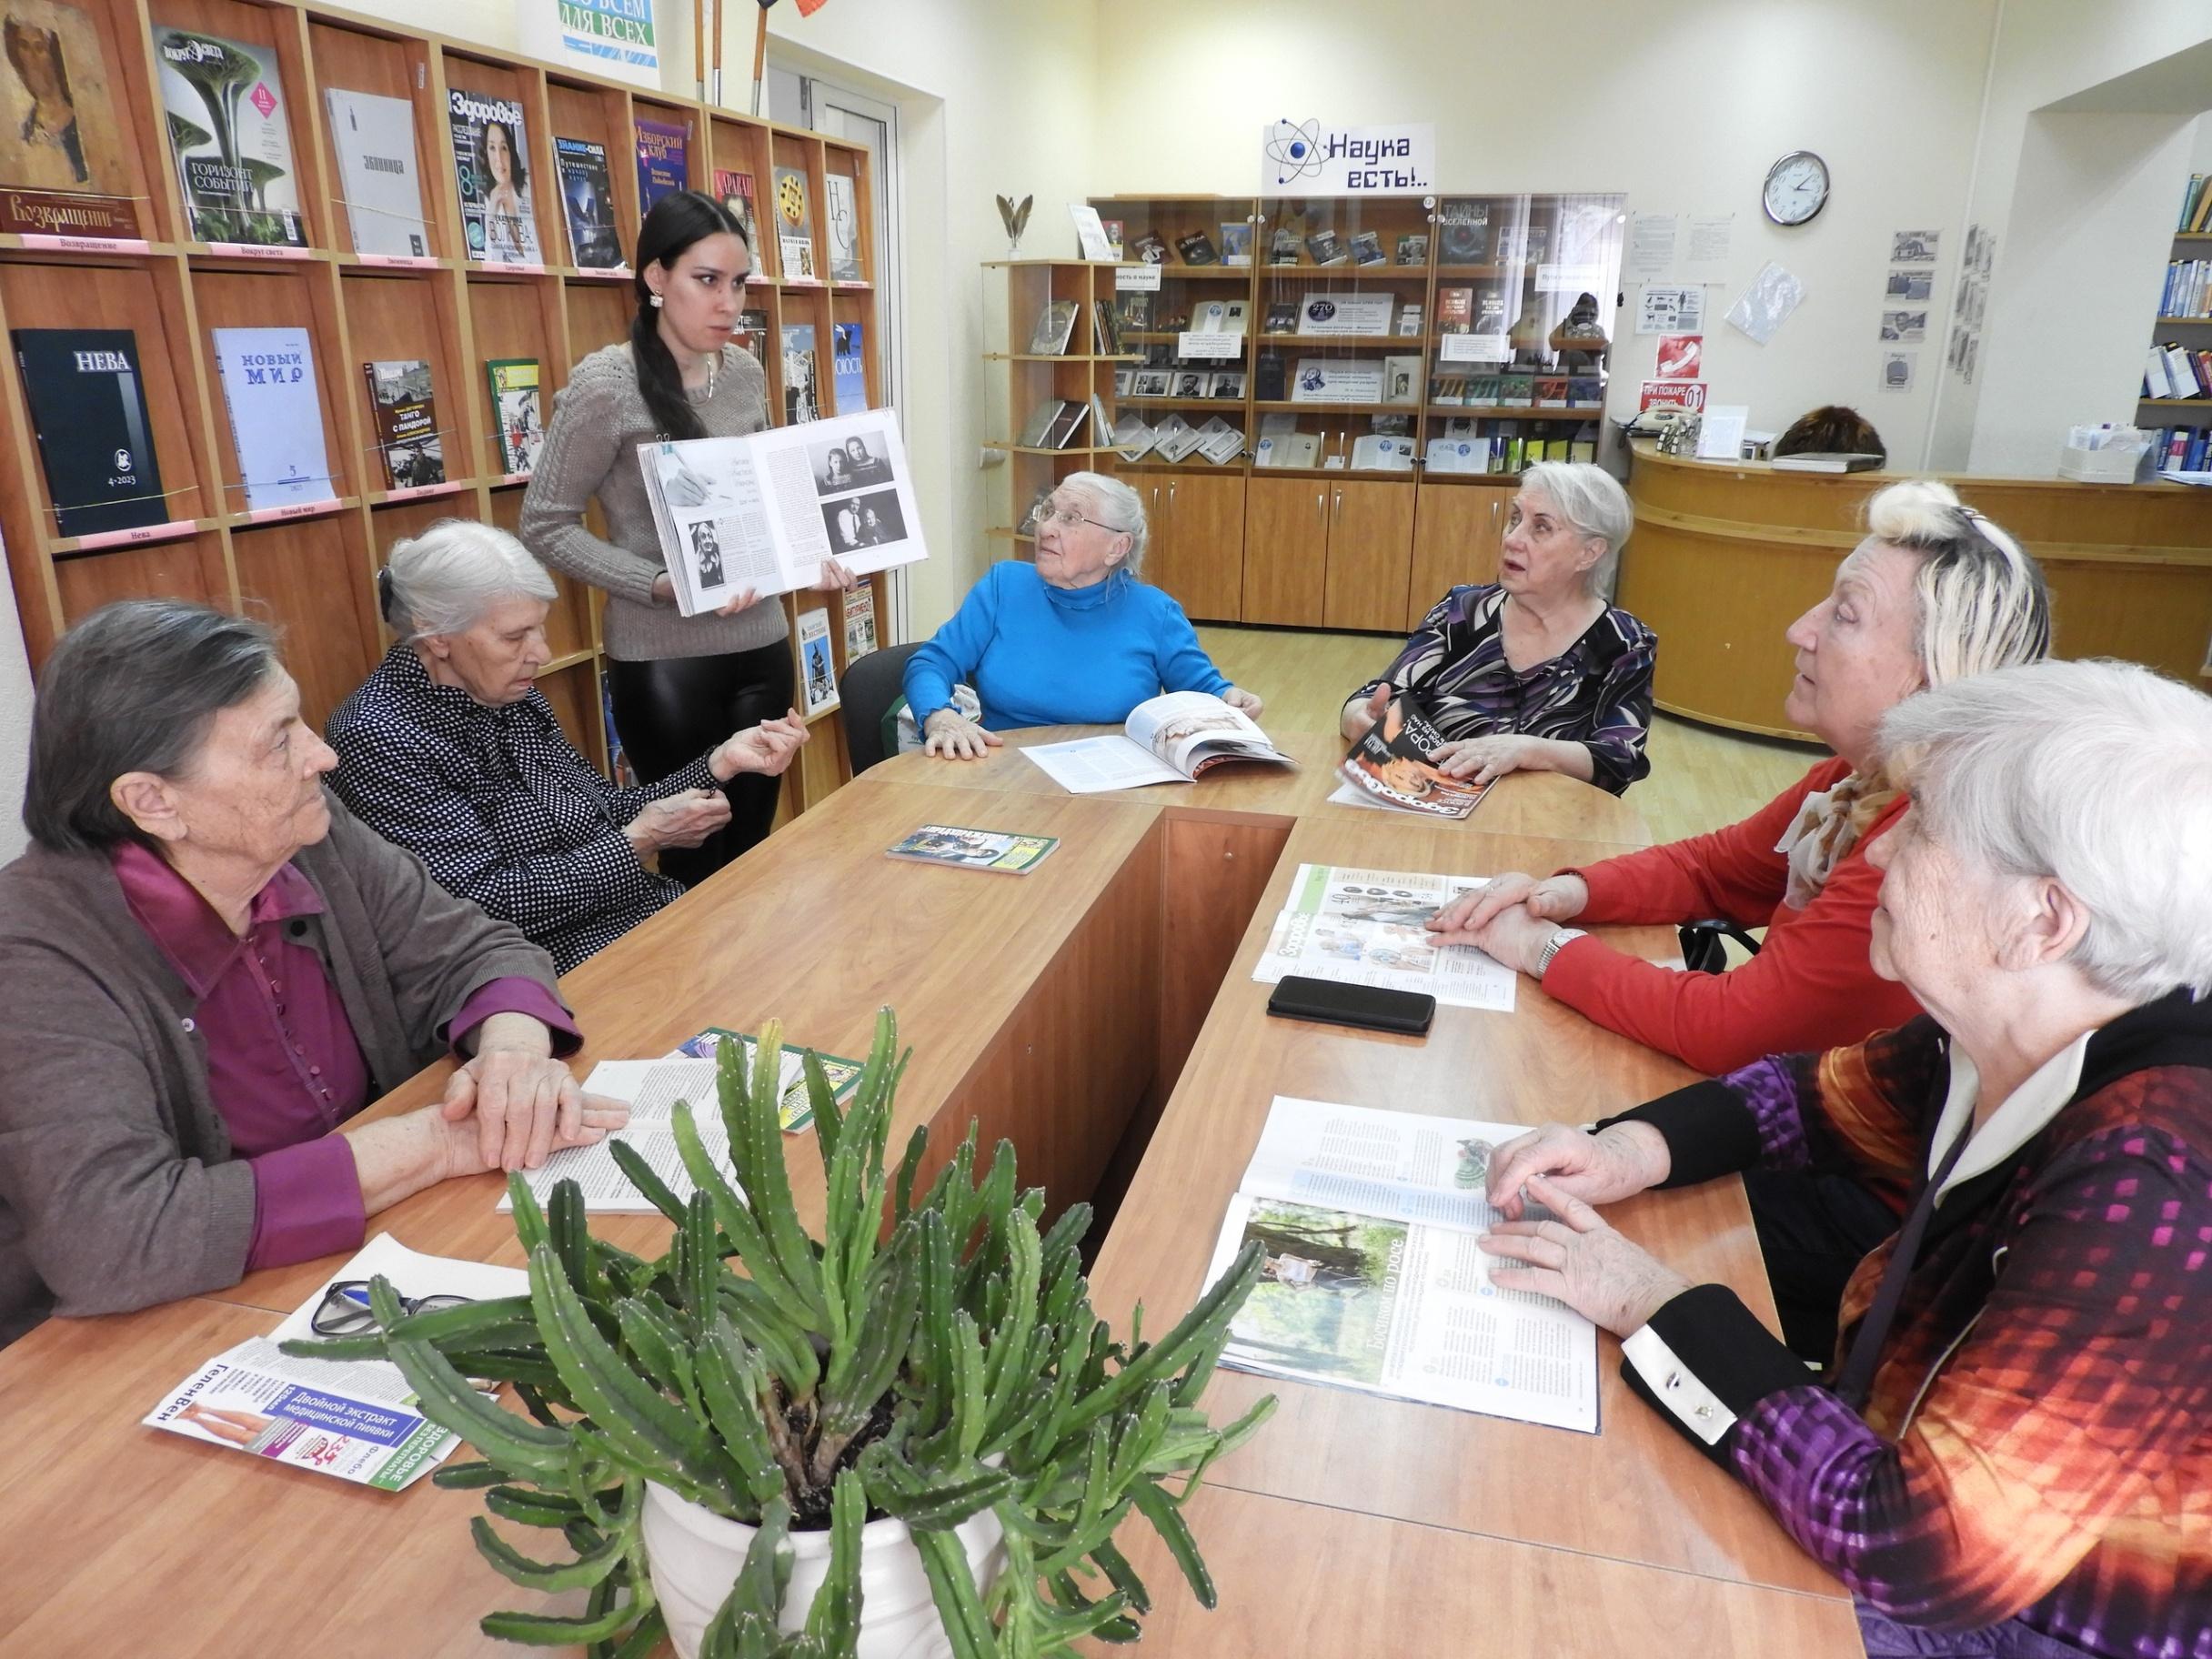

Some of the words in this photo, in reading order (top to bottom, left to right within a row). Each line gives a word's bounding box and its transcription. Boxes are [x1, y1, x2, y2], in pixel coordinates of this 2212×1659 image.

[601, 14, 649, 46] ВСЕХ
[451, 92, 523, 126] Здоровье
[1329, 133, 1411, 166] Наука
[191, 162, 254, 182] ГОРИЗОНТ
[1347, 166, 1428, 189] есть!..
[194, 176, 256, 194] СОБЫТИЙ
[1444, 200, 1489, 219] ТАЙНЫ
[59, 238, 117, 251] Возвращение
[1312, 303, 1333, 313] 270
[75, 349, 132, 373] НЕВА
[241, 353, 302, 367] НОВЫЙ
[1644, 386, 1658, 396] ПРИ
[1658, 386, 1686, 397] ПОЖАРЕ
[1685, 389, 1704, 408] 01
[399, 409, 420, 421] ТАНГО
[398, 417, 432, 434] ПАНДОРОЙ
[108, 474, 136, 487] 4-2023
[289, 465, 297, 477] 5
[280, 507, 302, 518] Новый
[303, 505, 316, 516] мир
[130, 530, 151, 540] Нева
[1344, 758, 1461, 815] Здоровье
[1278, 910, 1312, 958] Здоровье
[1387, 1238, 1404, 1274] росе
[1383, 1276, 1397, 1293] по
[1366, 1297, 1393, 1351] Босиком
[157, 1363, 229, 1422] ГеленВен
[291, 1392, 347, 1413] Двойной
[344, 1405, 397, 1428] экстракт
[283, 1403, 355, 1430] медицинской
[354, 1420, 395, 1439] пиявки
[420, 1423, 436, 1440] БЕЗ
[347, 1446, 379, 1474] Флебо
[389, 1425, 449, 1483] ЗДОРОВЬЕ
